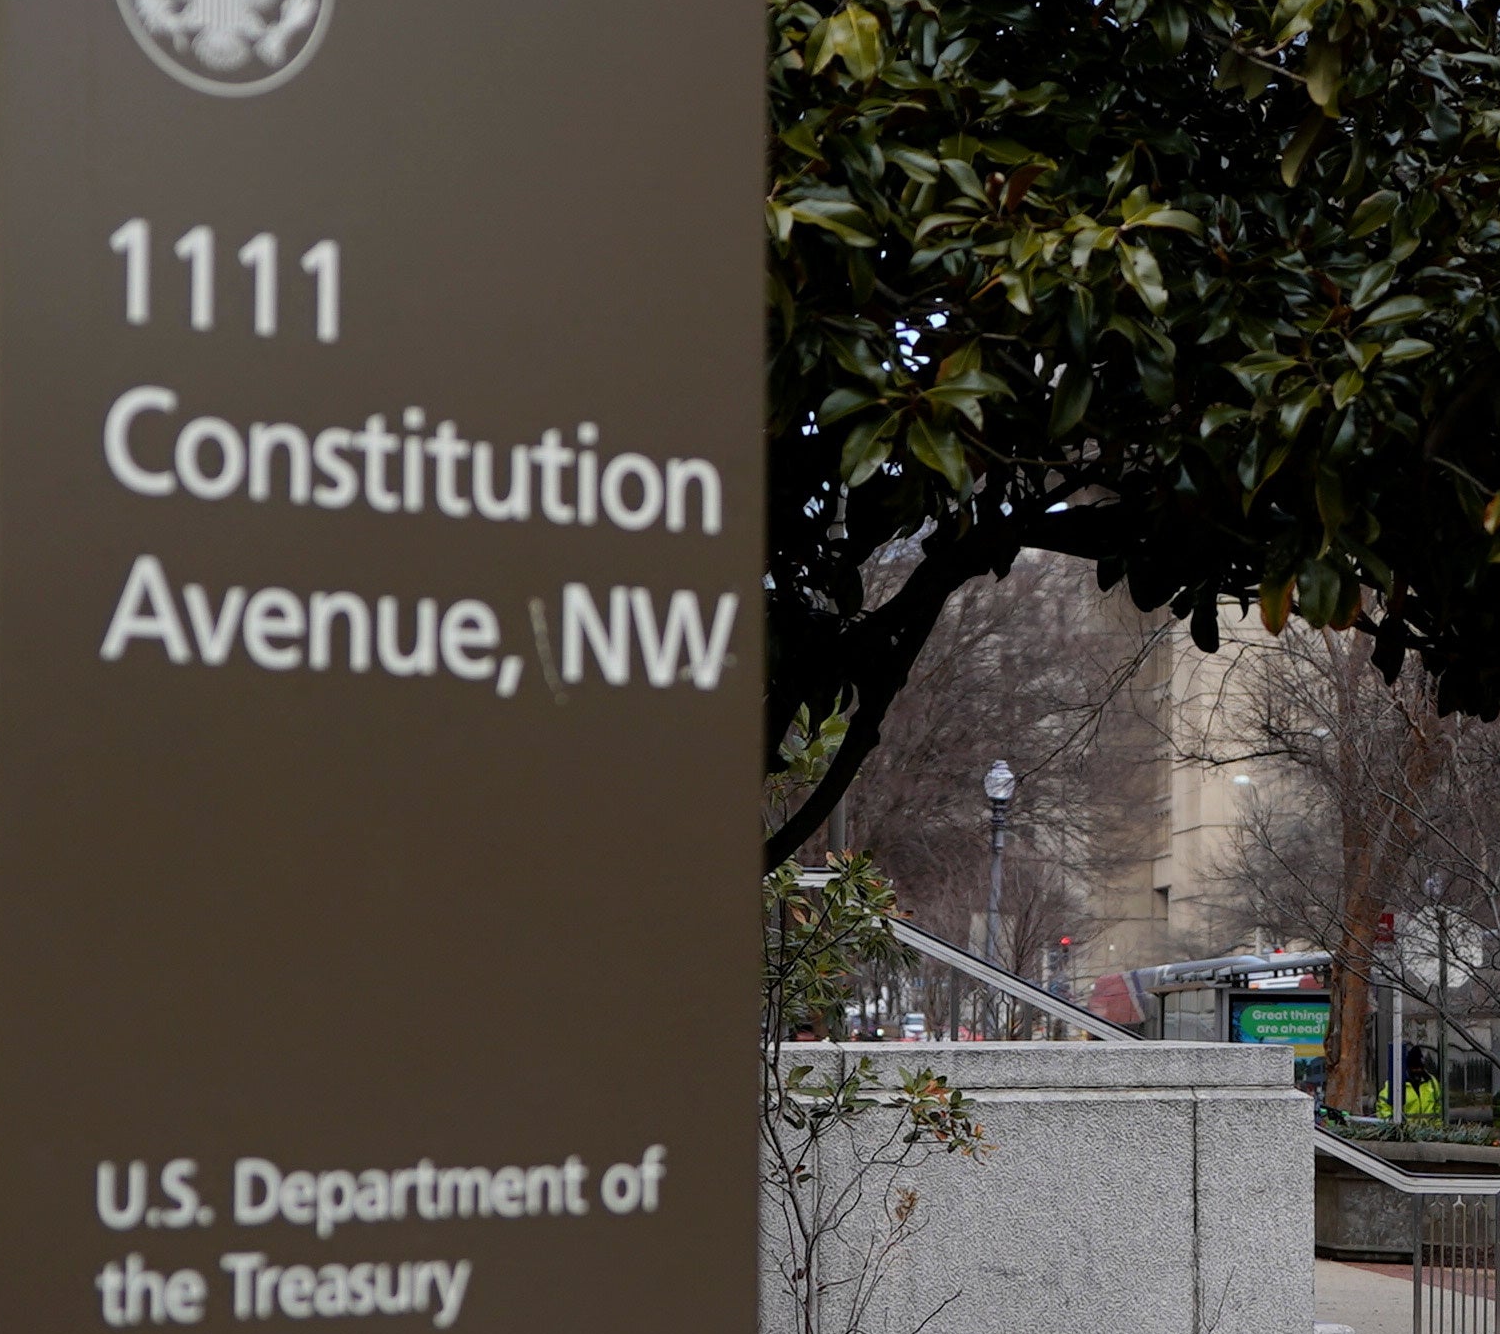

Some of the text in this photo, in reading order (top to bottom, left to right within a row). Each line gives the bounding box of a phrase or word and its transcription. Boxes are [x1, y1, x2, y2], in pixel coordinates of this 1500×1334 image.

[109, 217, 341, 344] 1111
[102, 385, 722, 535] Constitution
[99, 553, 738, 697] Avenue, NW
[1252, 1009, 1288, 1020] Great
[1256, 1022, 1326, 1035] are ahead!
[97, 1142, 668, 1240] U.S. Department of
[96, 1251, 473, 1329] the Treasury
